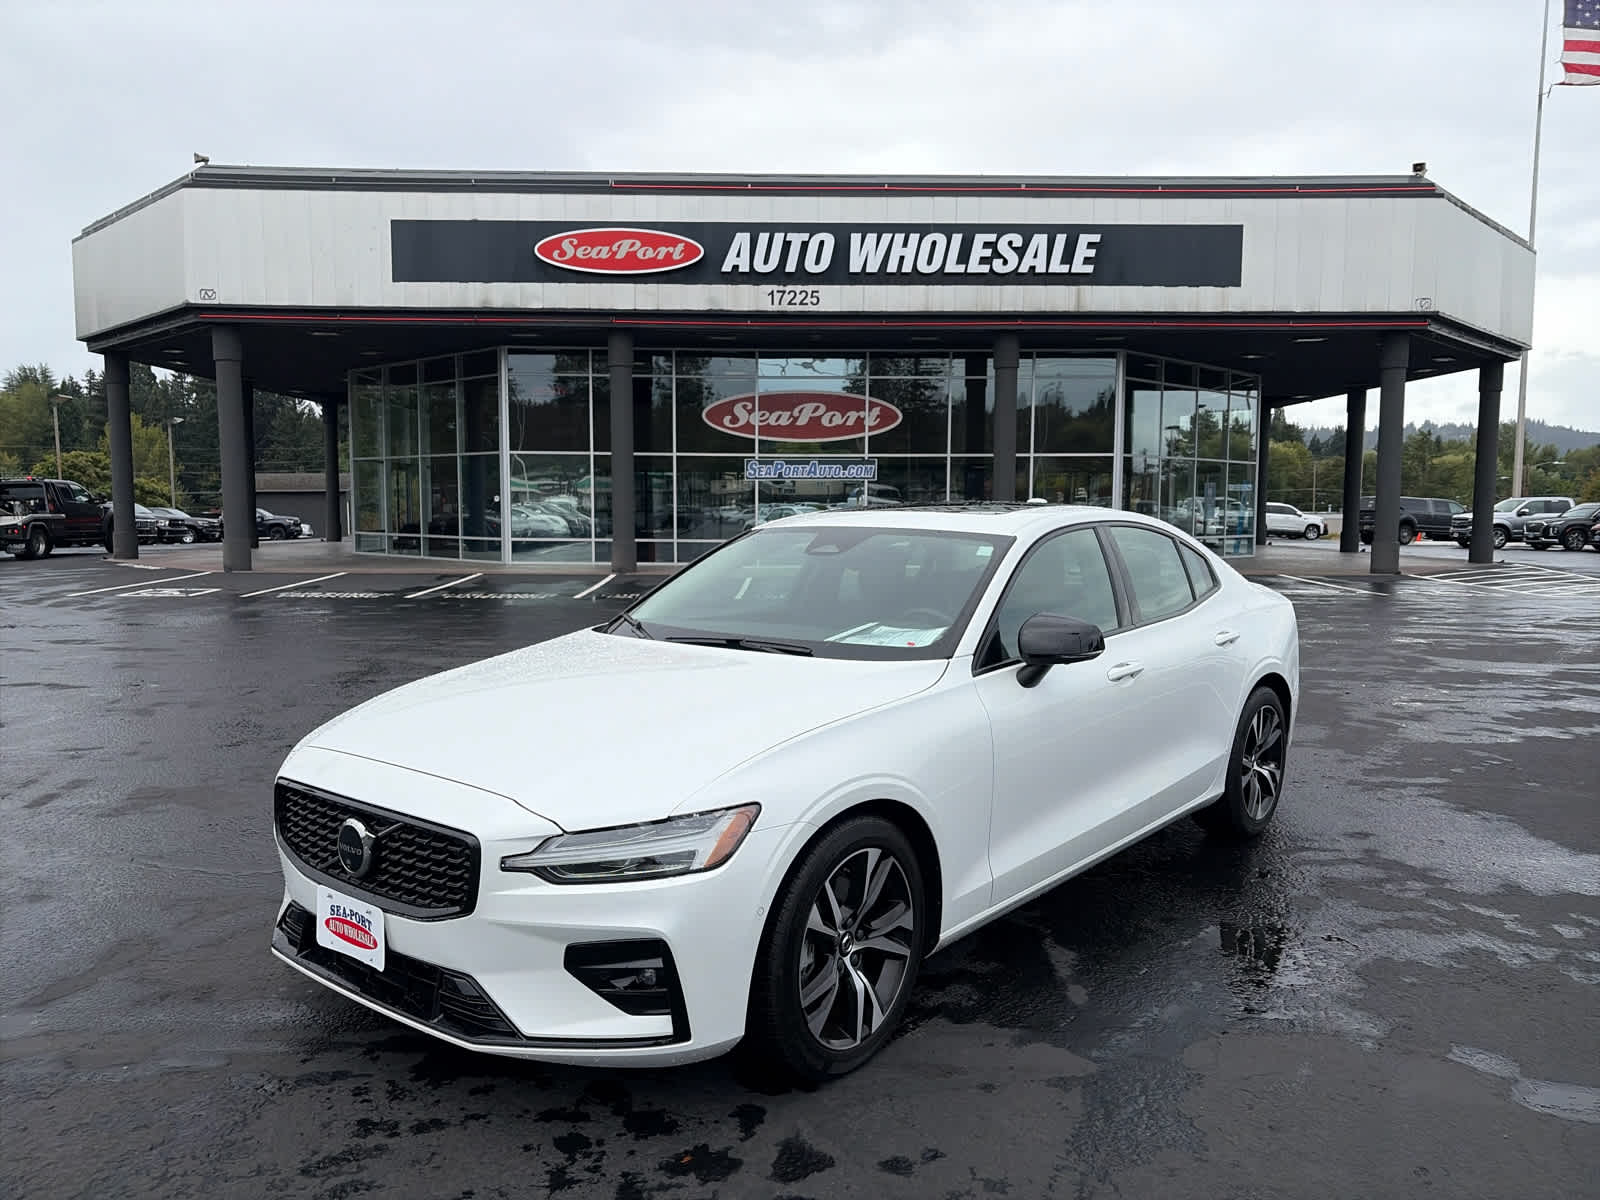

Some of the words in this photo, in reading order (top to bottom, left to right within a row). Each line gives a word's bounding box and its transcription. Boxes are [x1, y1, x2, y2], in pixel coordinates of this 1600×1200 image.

[552, 238, 686, 261] SeaPort
[720, 231, 836, 273] AUTO
[849, 232, 1101, 274] WHOLESALE
[767, 289, 821, 306] 17225
[723, 401, 881, 428] SeaPort
[329, 918, 344, 935] AUTO
[343, 924, 376, 949] WHOLESALE
